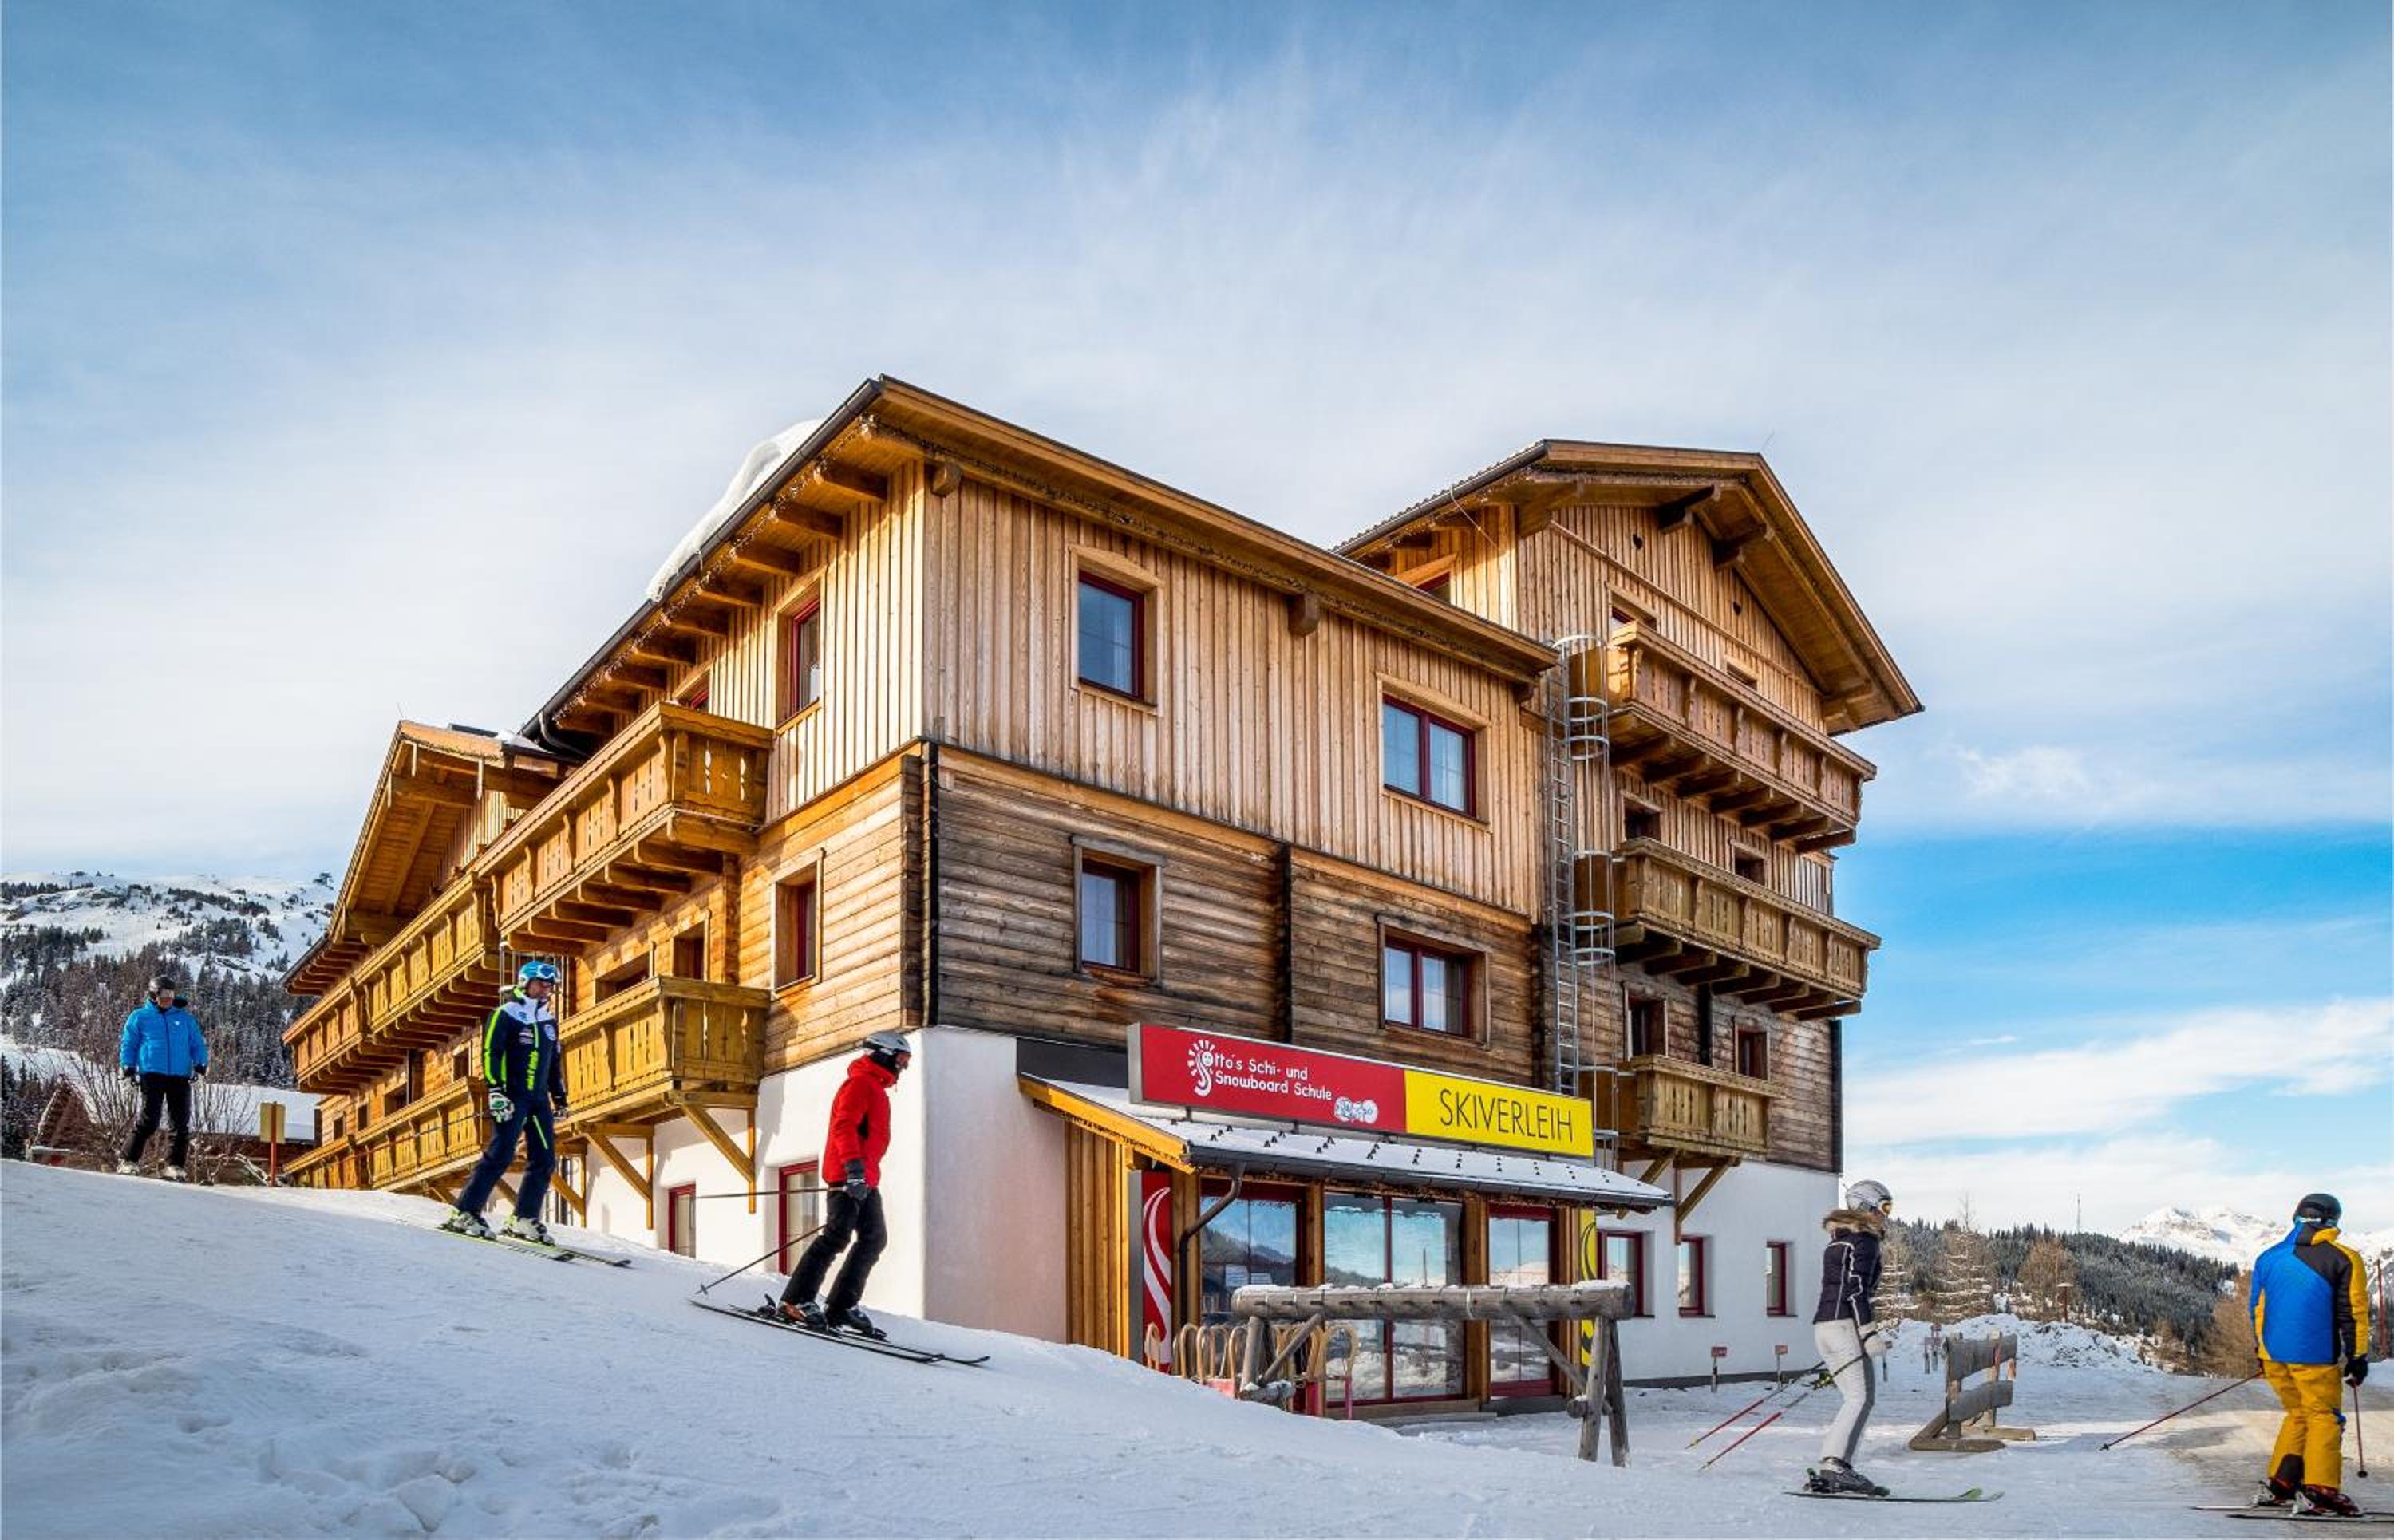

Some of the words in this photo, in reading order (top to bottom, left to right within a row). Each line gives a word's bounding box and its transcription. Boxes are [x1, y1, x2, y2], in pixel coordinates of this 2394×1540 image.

[1248, 1058, 1281, 1075] Schi-
[1286, 1067, 1308, 1080] und
[1215, 1070, 1289, 1093] Snowboard
[1294, 1082, 1333, 1100] Schule
[1439, 1088, 1574, 1143] SKIVERLEIH
